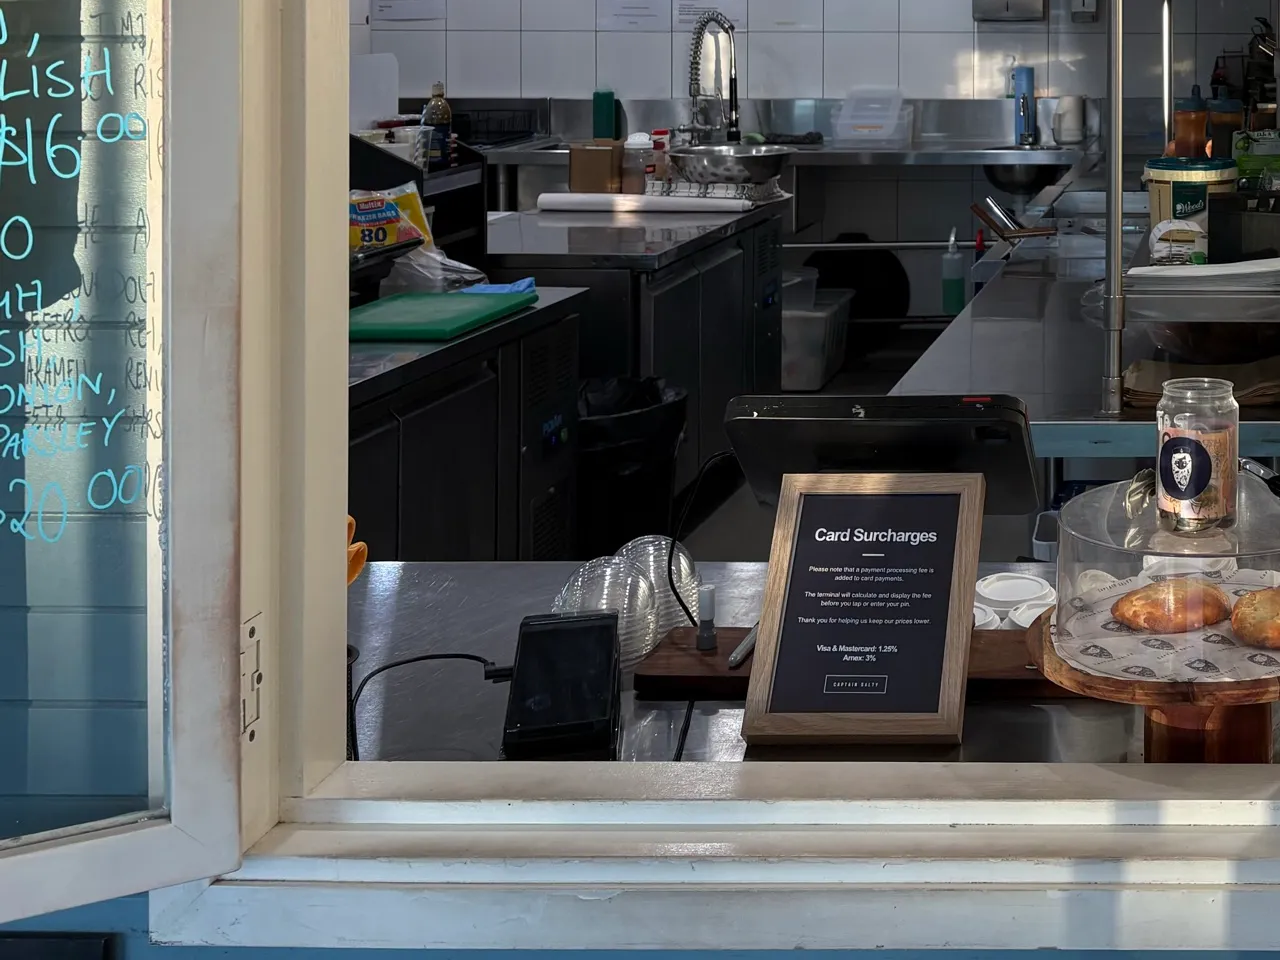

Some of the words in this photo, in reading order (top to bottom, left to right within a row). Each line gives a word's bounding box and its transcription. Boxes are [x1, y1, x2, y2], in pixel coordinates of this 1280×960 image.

[361, 227, 387, 243] 80
[0, 465, 144, 544] 20.00
[815, 528, 850, 541] Card
[853, 528, 937, 546] Surcharges
